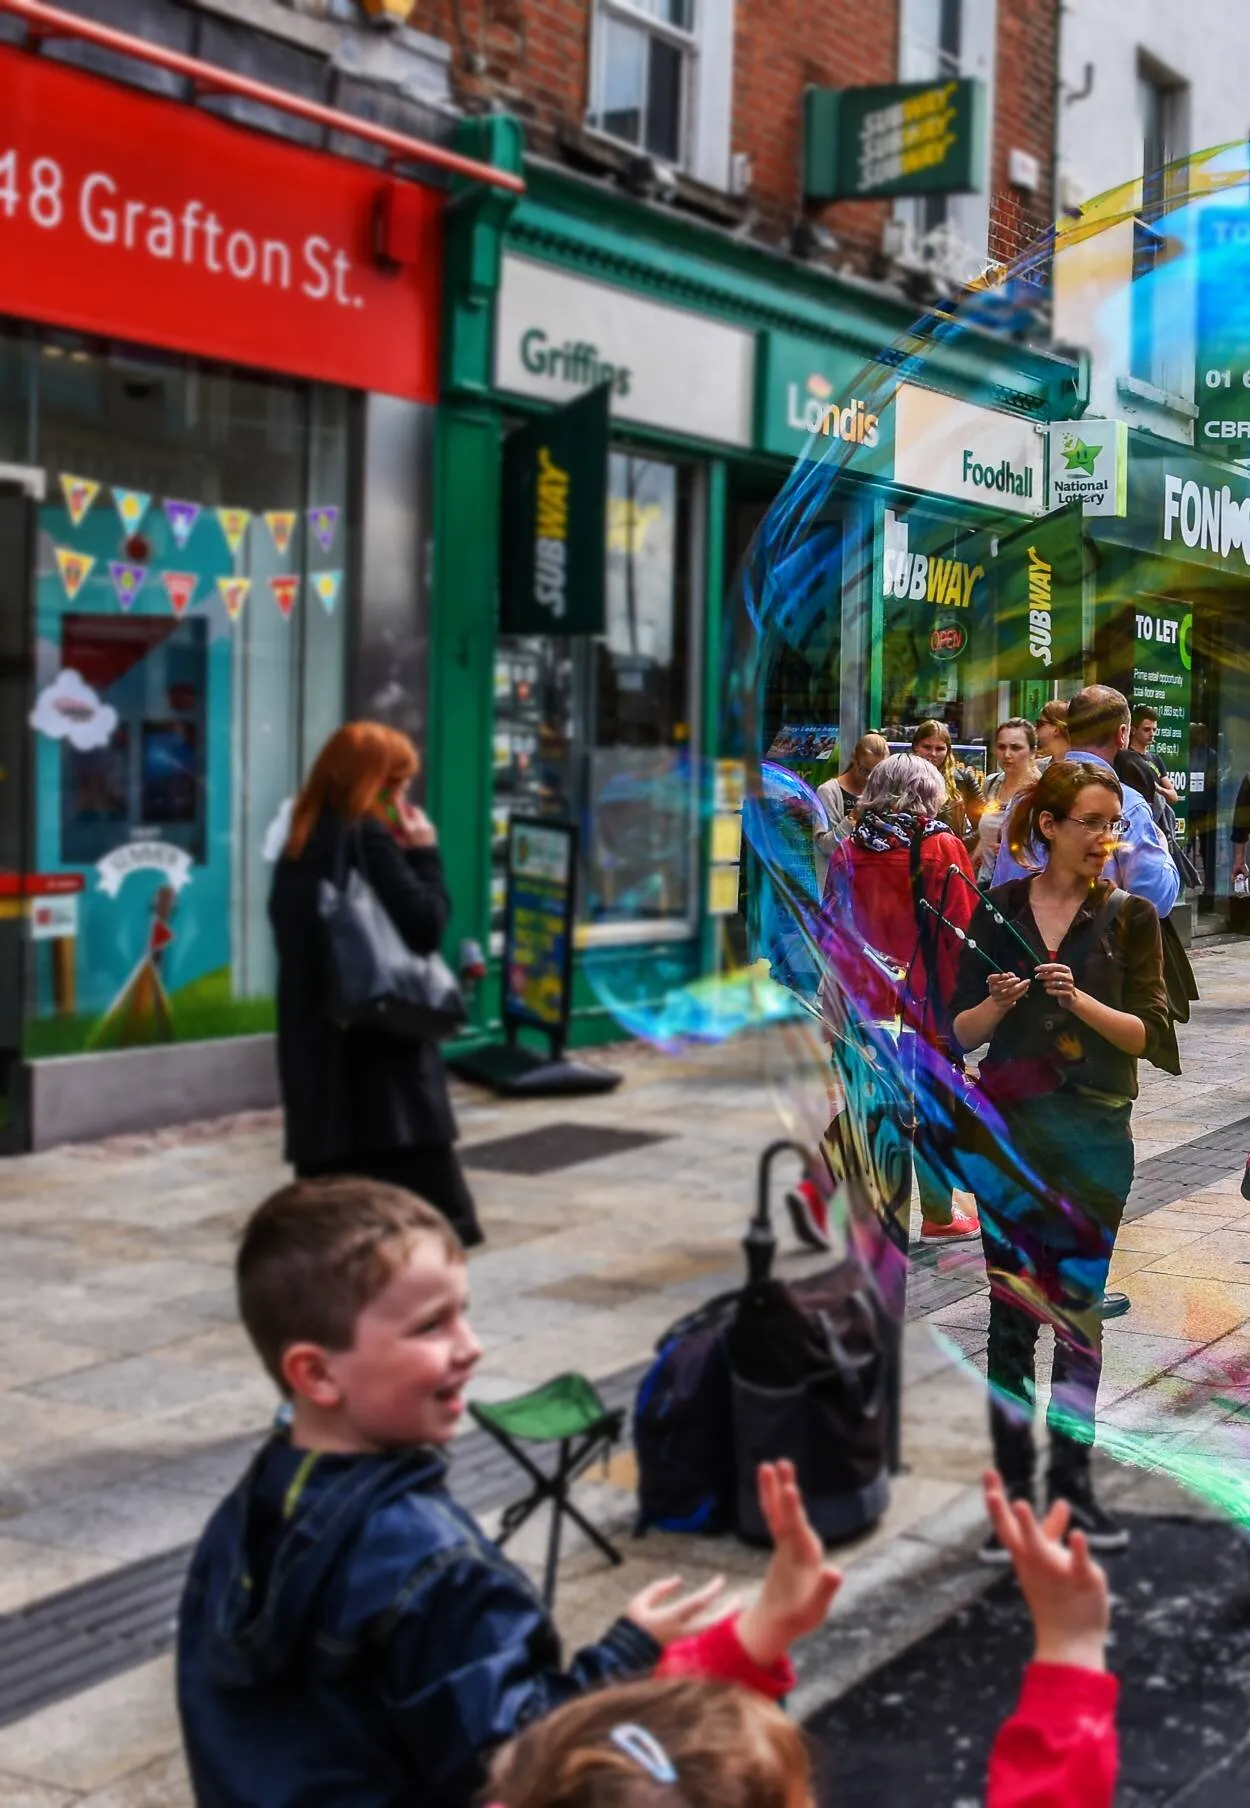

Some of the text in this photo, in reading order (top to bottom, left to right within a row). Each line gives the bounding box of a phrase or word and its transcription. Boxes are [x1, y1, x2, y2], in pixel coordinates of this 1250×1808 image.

[0, 149, 364, 309] 48 Grafton St.
[520, 327, 632, 396] Griffins
[1205, 370, 1231, 388] 01
[788, 383, 880, 448] Londis
[963, 449, 1033, 498] Foodhall
[1054, 480, 1109, 491] National
[1058, 493, 1105, 506] Lottery
[534, 447, 569, 618] SUBWAY
[883, 551, 985, 608] SUBWAY
[1027, 545, 1053, 667] SUBWAY
[931, 628, 962, 653] OPEN
[1136, 614, 1178, 644] TO LET
